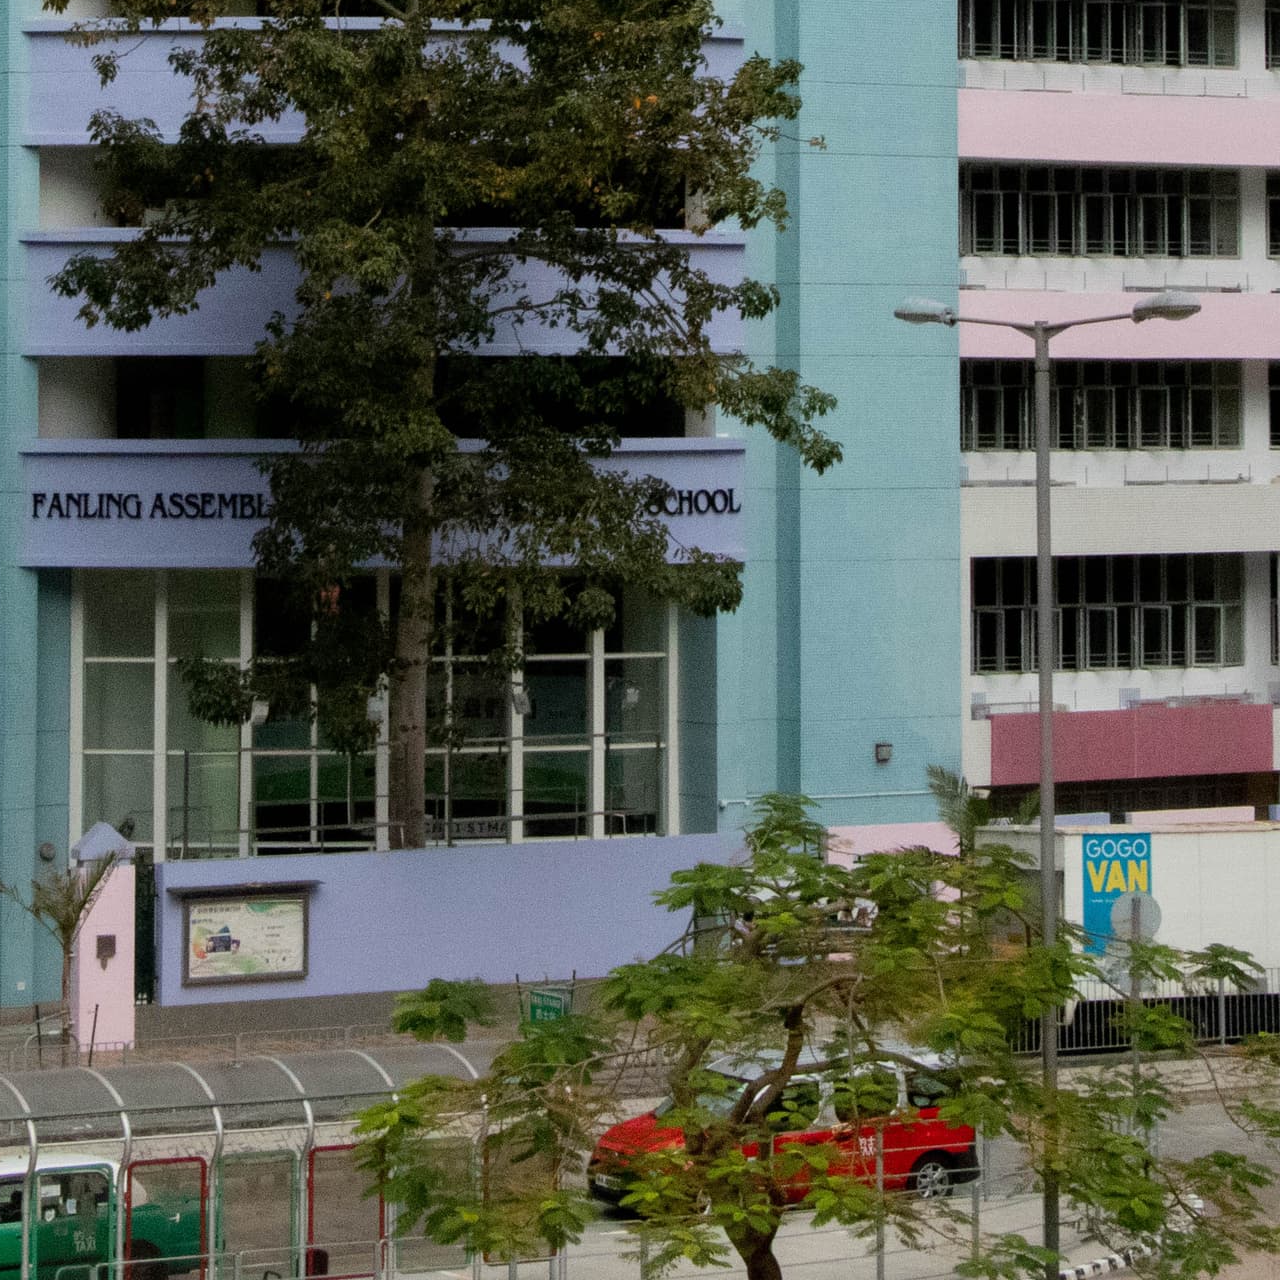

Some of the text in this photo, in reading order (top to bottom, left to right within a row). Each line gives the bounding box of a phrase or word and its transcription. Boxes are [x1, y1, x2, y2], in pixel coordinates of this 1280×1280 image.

[31, 492, 142, 519] FANLING
[149, 492, 271, 519] ASSEMBL
[1086, 839, 1148, 858] GOGO
[1086, 859, 1148, 893] VAN
